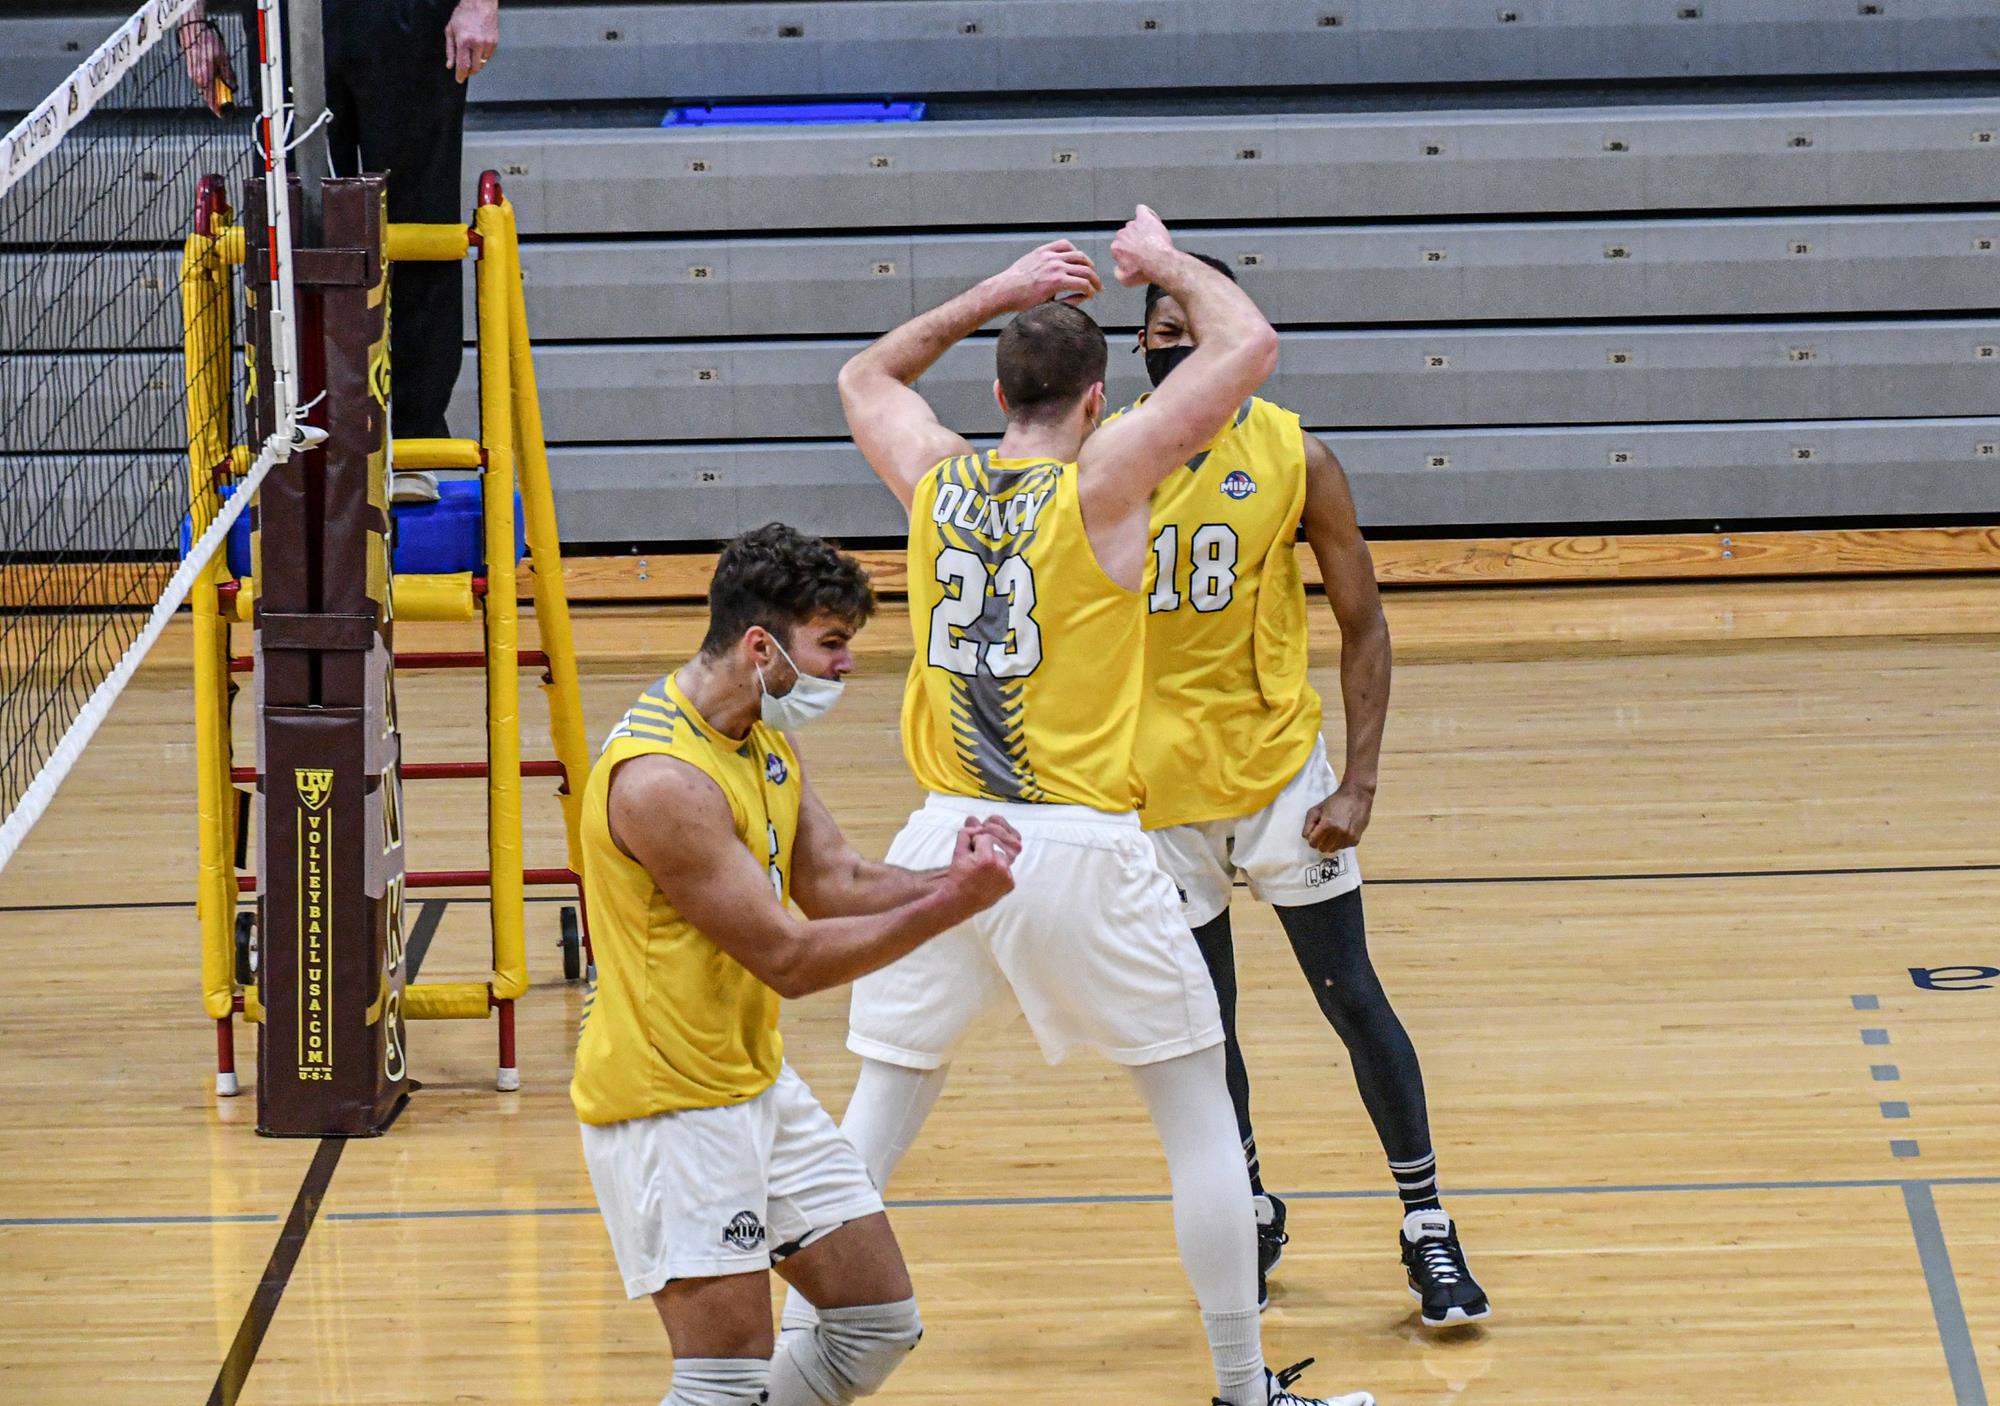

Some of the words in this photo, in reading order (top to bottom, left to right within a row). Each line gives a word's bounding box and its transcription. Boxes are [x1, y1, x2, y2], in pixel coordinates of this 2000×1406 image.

[1144, 21, 1156, 29] 32
[1980, 133, 1990, 142] 32
[1060, 154, 1072, 162] 27
[1796, 245, 1807, 253] 31
[1980, 240, 1991, 249] 32
[1245, 256, 1257, 265] 28
[1428, 252, 1440, 261] 29
[695, 269, 707, 277] 25
[879, 264, 890, 273] 26
[1798, 351, 1809, 360] 31
[1981, 348, 1992, 356] 32
[1431, 357, 1443, 366] 29
[1614, 354, 1626, 363] 30
[700, 371, 711, 380] 25
[1798, 450, 1810, 458] 30
[1982, 445, 1993, 454] 31
[1432, 458, 1444, 466] 28
[1615, 454, 1627, 462] 29
[703, 473, 715, 481] 24
[1220, 481, 1256, 493] MIVA
[932, 482, 1048, 540] QUNCY
[1149, 523, 1239, 613] 18
[928, 546, 1043, 679] 23
[723, 1225, 765, 1242] MIVA
